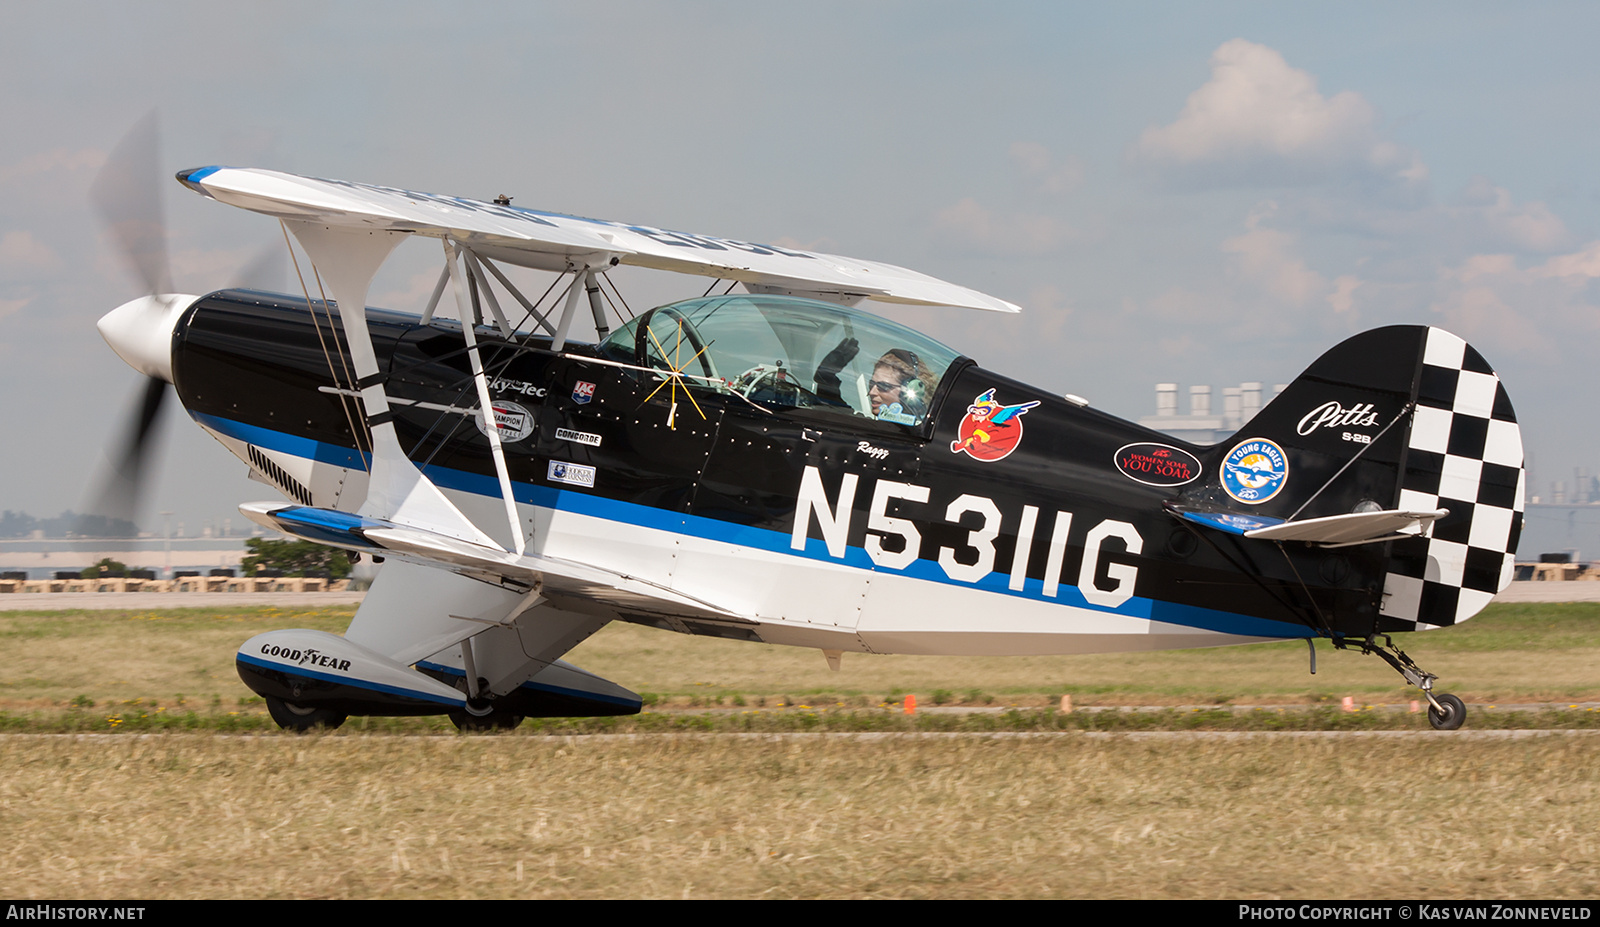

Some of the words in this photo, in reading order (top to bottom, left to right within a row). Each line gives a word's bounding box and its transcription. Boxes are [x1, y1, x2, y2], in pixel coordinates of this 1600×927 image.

[574, 382, 594, 394] IAC
[494, 414, 521, 426] HAMPION
[1297, 401, 1379, 436] Pitts
[557, 429, 599, 444] CONCORDE
[1130, 453, 1165, 465] WOMEN
[1165, 460, 1187, 470] SOAR
[1231, 443, 1259, 461] YOUNG
[1261, 444, 1283, 468] EAGLES
[1122, 458, 1152, 473] YOU
[1154, 466, 1191, 480] SOAR
[790, 465, 1144, 608] N5311G
